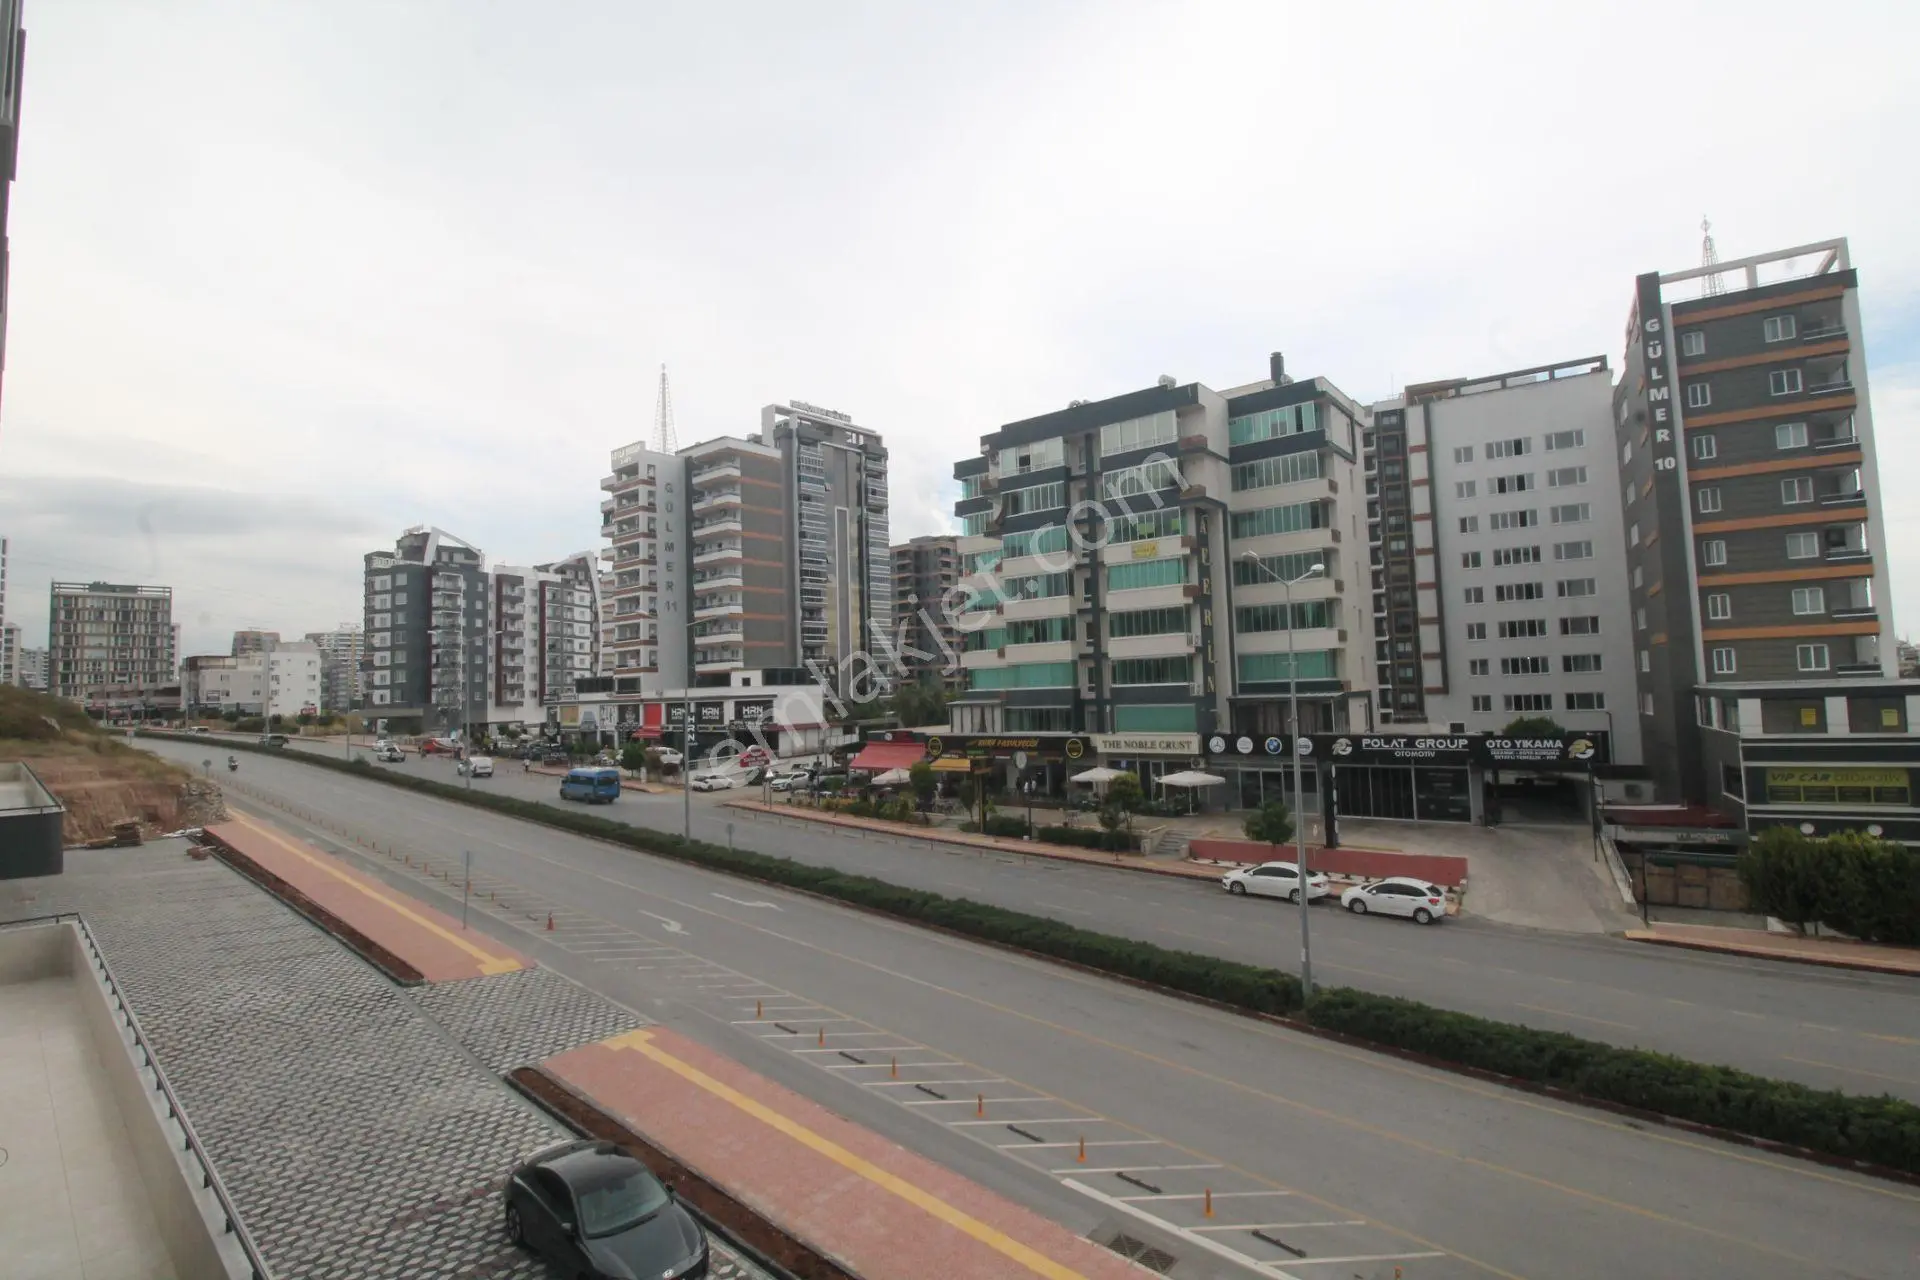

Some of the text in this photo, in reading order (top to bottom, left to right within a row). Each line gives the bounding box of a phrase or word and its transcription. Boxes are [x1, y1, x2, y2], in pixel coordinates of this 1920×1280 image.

[1645, 319, 1676, 471] GÜLMER 10
[702, 706, 720, 716] HRN
[742, 704, 763, 715] HRN
[687, 715, 696, 742] HRN
[1102, 739, 1193, 750] THE NOBLE CRUST
[1361, 738, 1468, 749] POLAT GROUP
[1485, 739, 1563, 749] OTO YIKAMA
[1800, 772, 1833, 782] CAR
